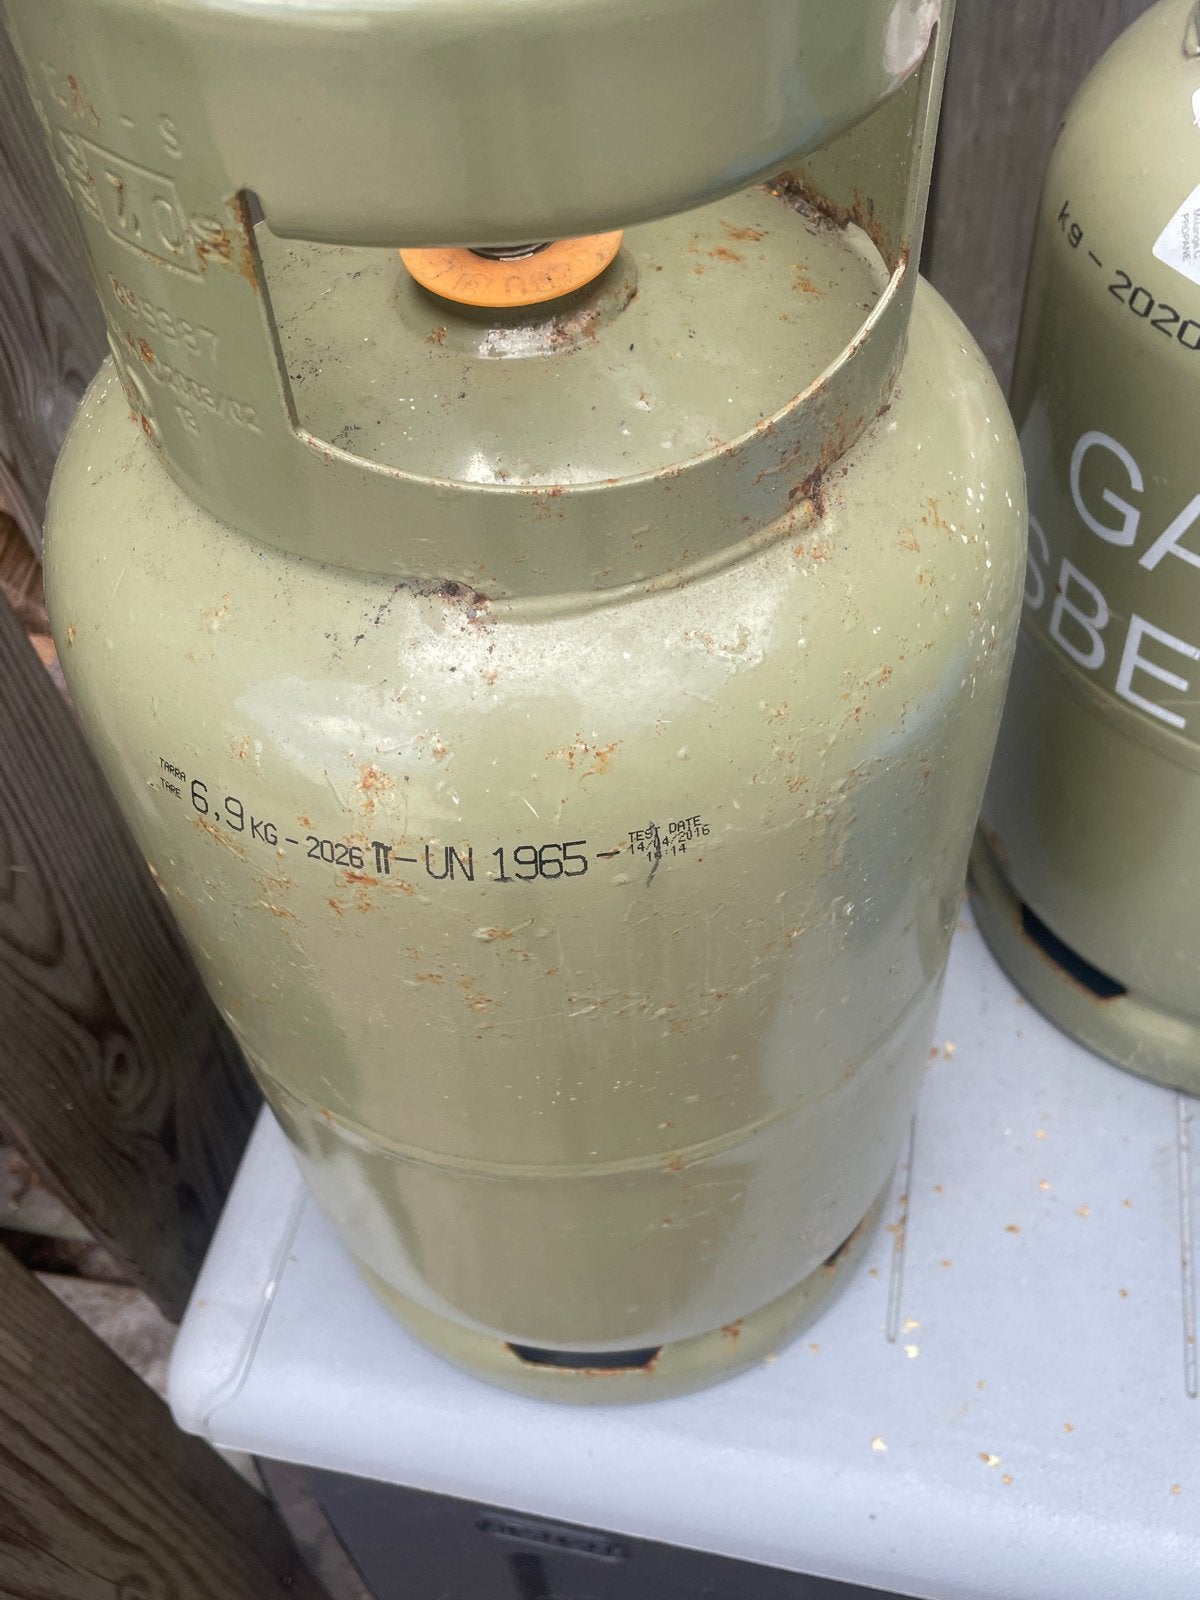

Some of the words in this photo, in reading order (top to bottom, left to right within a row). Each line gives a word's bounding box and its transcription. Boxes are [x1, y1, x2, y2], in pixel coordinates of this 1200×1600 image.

[1058, 200, 1083, 248] kg
[159, 757, 186, 782] TARRA
[160, 777, 182, 800] TARE
[191, 780, 244, 832] 6,9
[250, 817, 278, 846] KG
[306, 836, 364, 870] 2026
[425, 845, 475, 882] UN
[492, 841, 588, 882] 1965
[669, 815, 702, 834] DATE
